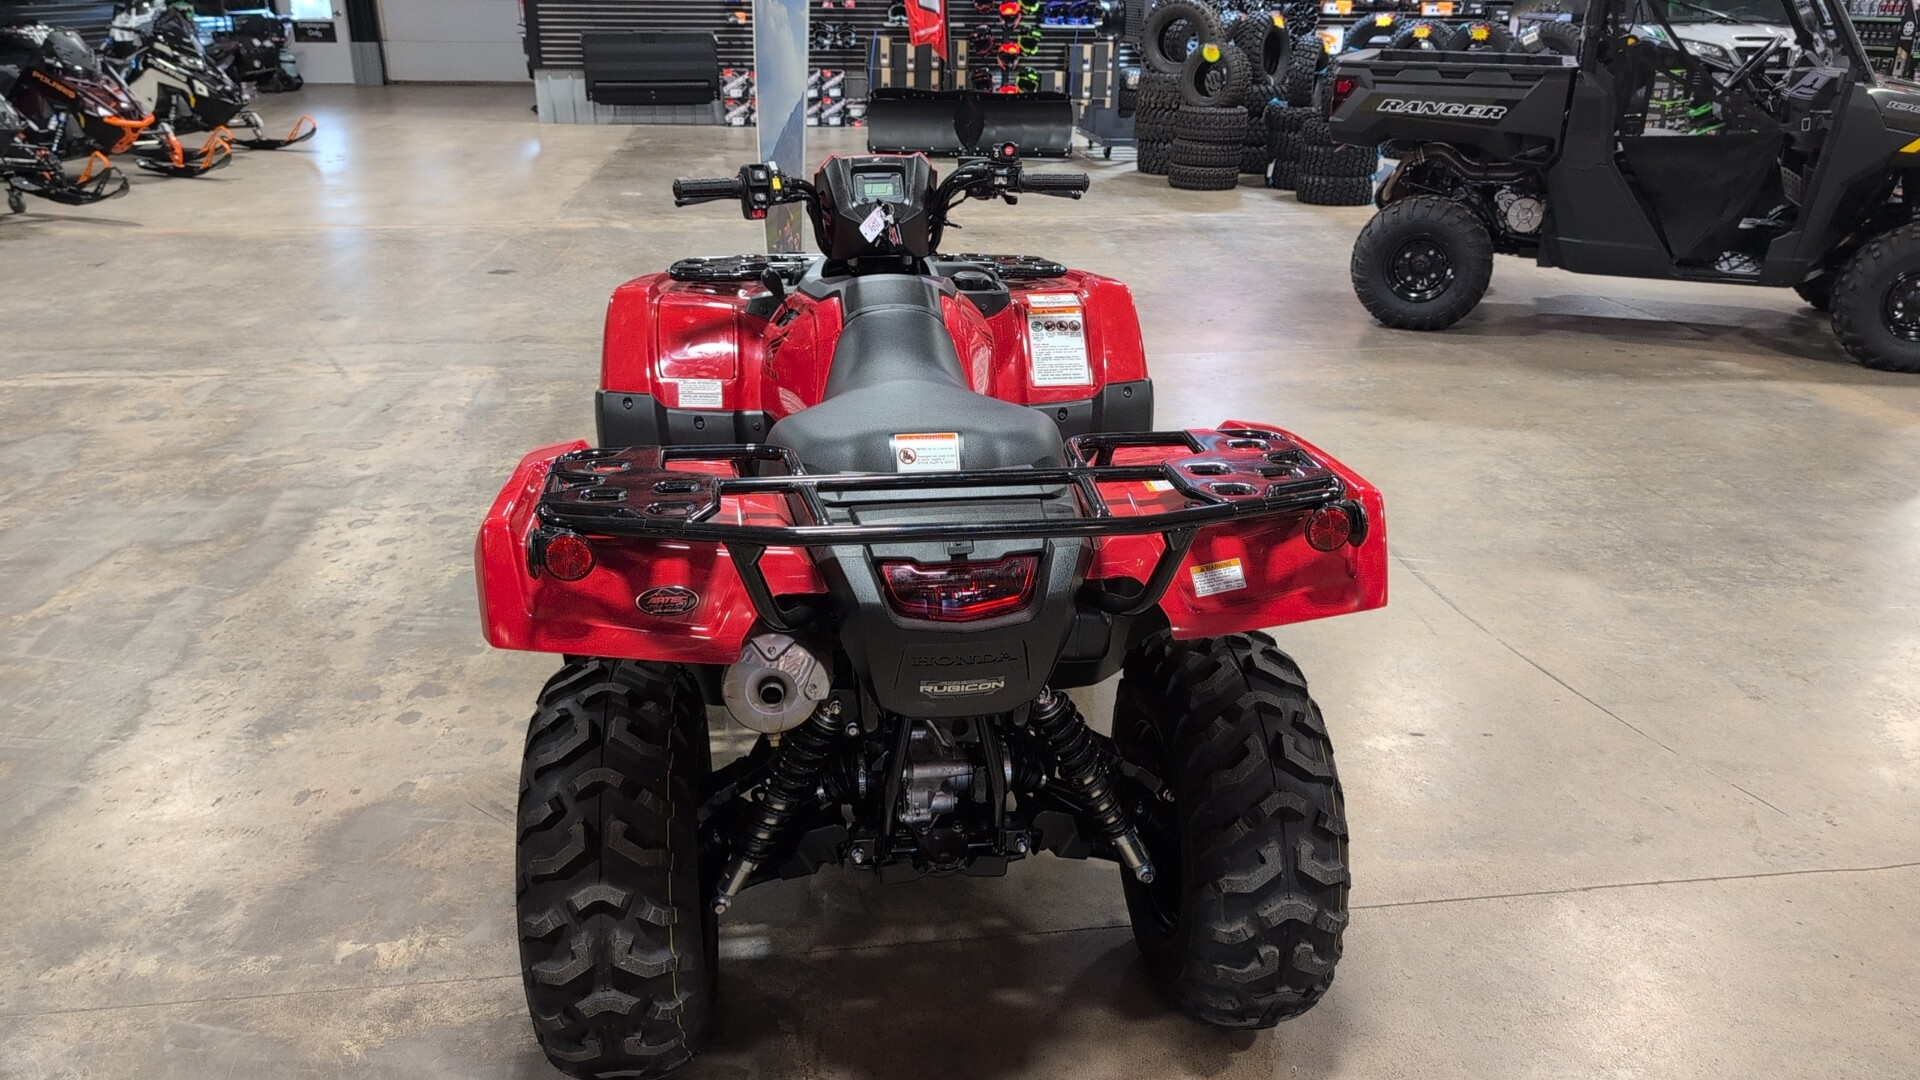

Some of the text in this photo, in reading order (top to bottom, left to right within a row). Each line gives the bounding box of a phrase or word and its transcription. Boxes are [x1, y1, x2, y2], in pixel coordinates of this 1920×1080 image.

[31, 70, 76, 98] POLARIS
[1377, 99, 1507, 119] RANGER
[1206, 560, 1232, 571] WARNING
[911, 652, 1018, 667] HONDA
[920, 681, 1005, 693] RUBICON
